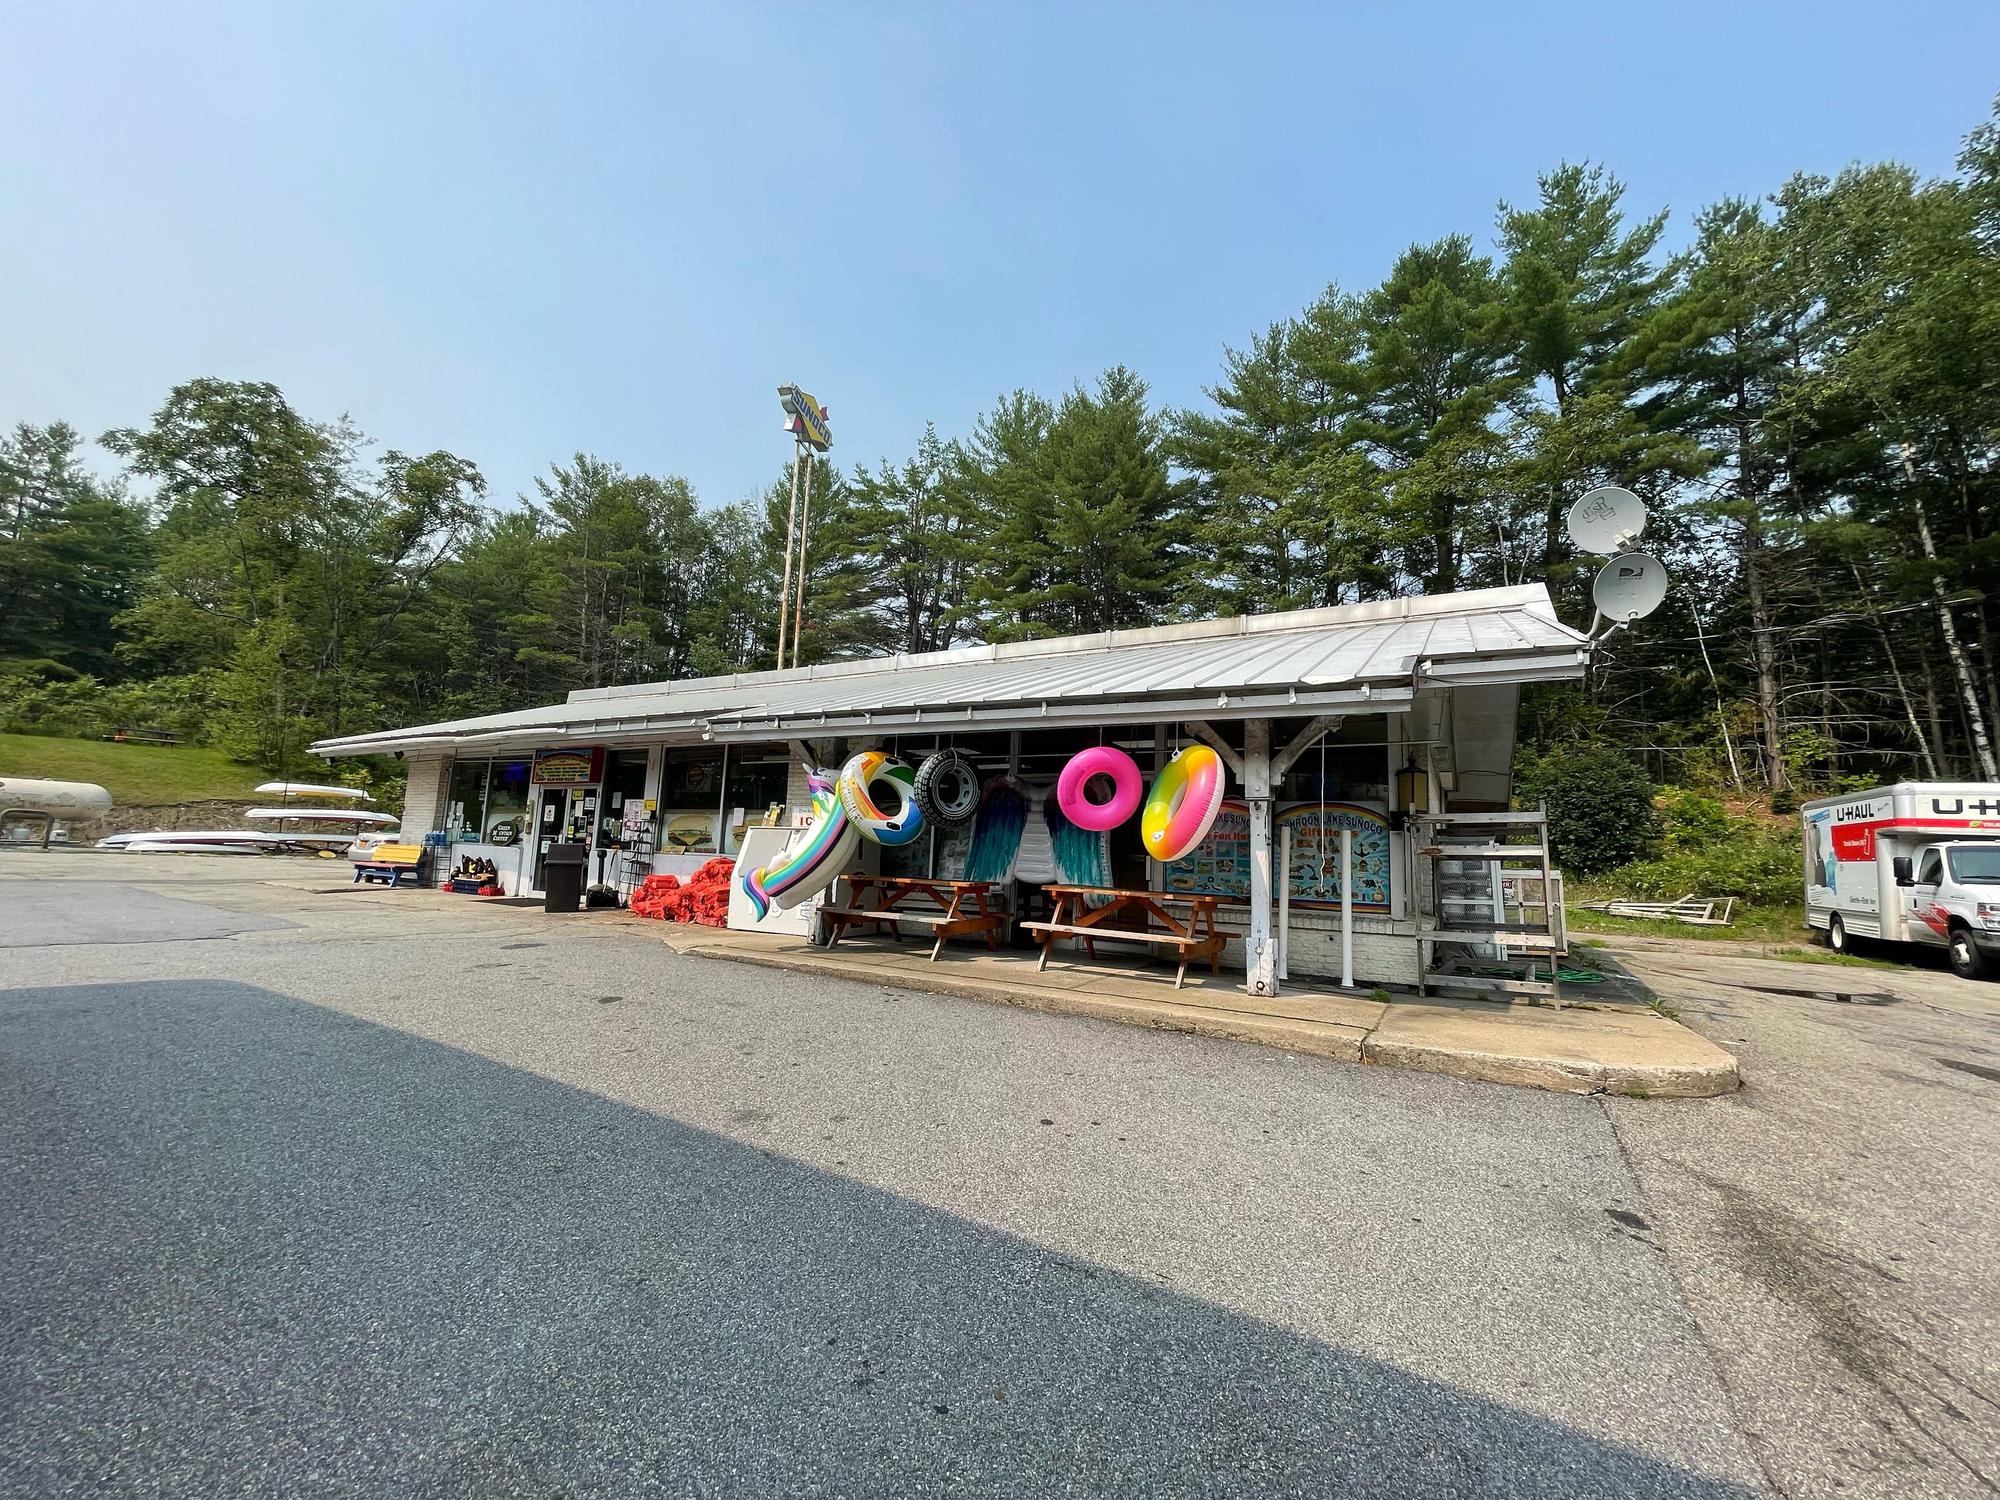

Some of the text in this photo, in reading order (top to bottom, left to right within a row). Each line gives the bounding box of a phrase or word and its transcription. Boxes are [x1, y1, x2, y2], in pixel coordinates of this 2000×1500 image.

[793, 390, 831, 445] SUNOCO
[1836, 803, 1874, 821] U-HAUL
[1300, 827, 1358, 838] Gift Ites
[1323, 815, 1344, 825] LAKE
[1346, 815, 1383, 835] SUNOCO
